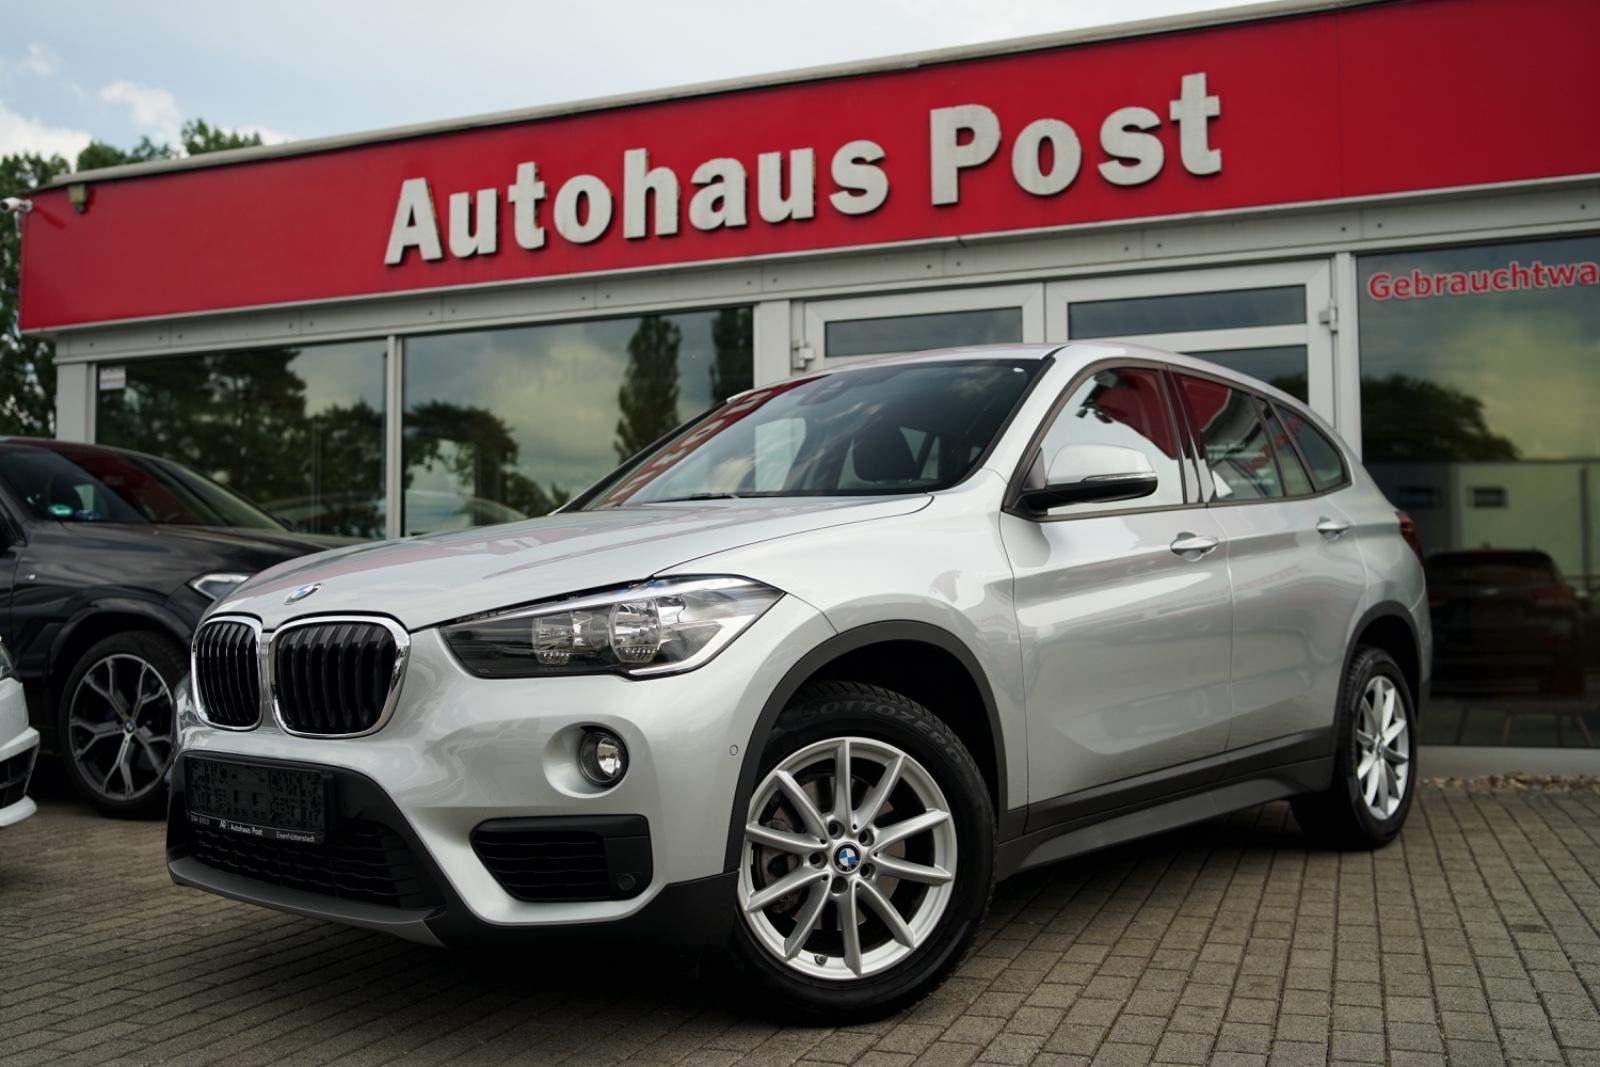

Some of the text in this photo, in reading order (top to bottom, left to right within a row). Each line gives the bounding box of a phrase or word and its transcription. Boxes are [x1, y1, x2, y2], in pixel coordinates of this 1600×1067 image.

[383, 72, 1222, 266] Autohaus Post
[1366, 260, 1599, 300] Gebrauchtwa
[230, 823, 251, 834] Autohaus
[251, 827, 263, 837] Post
